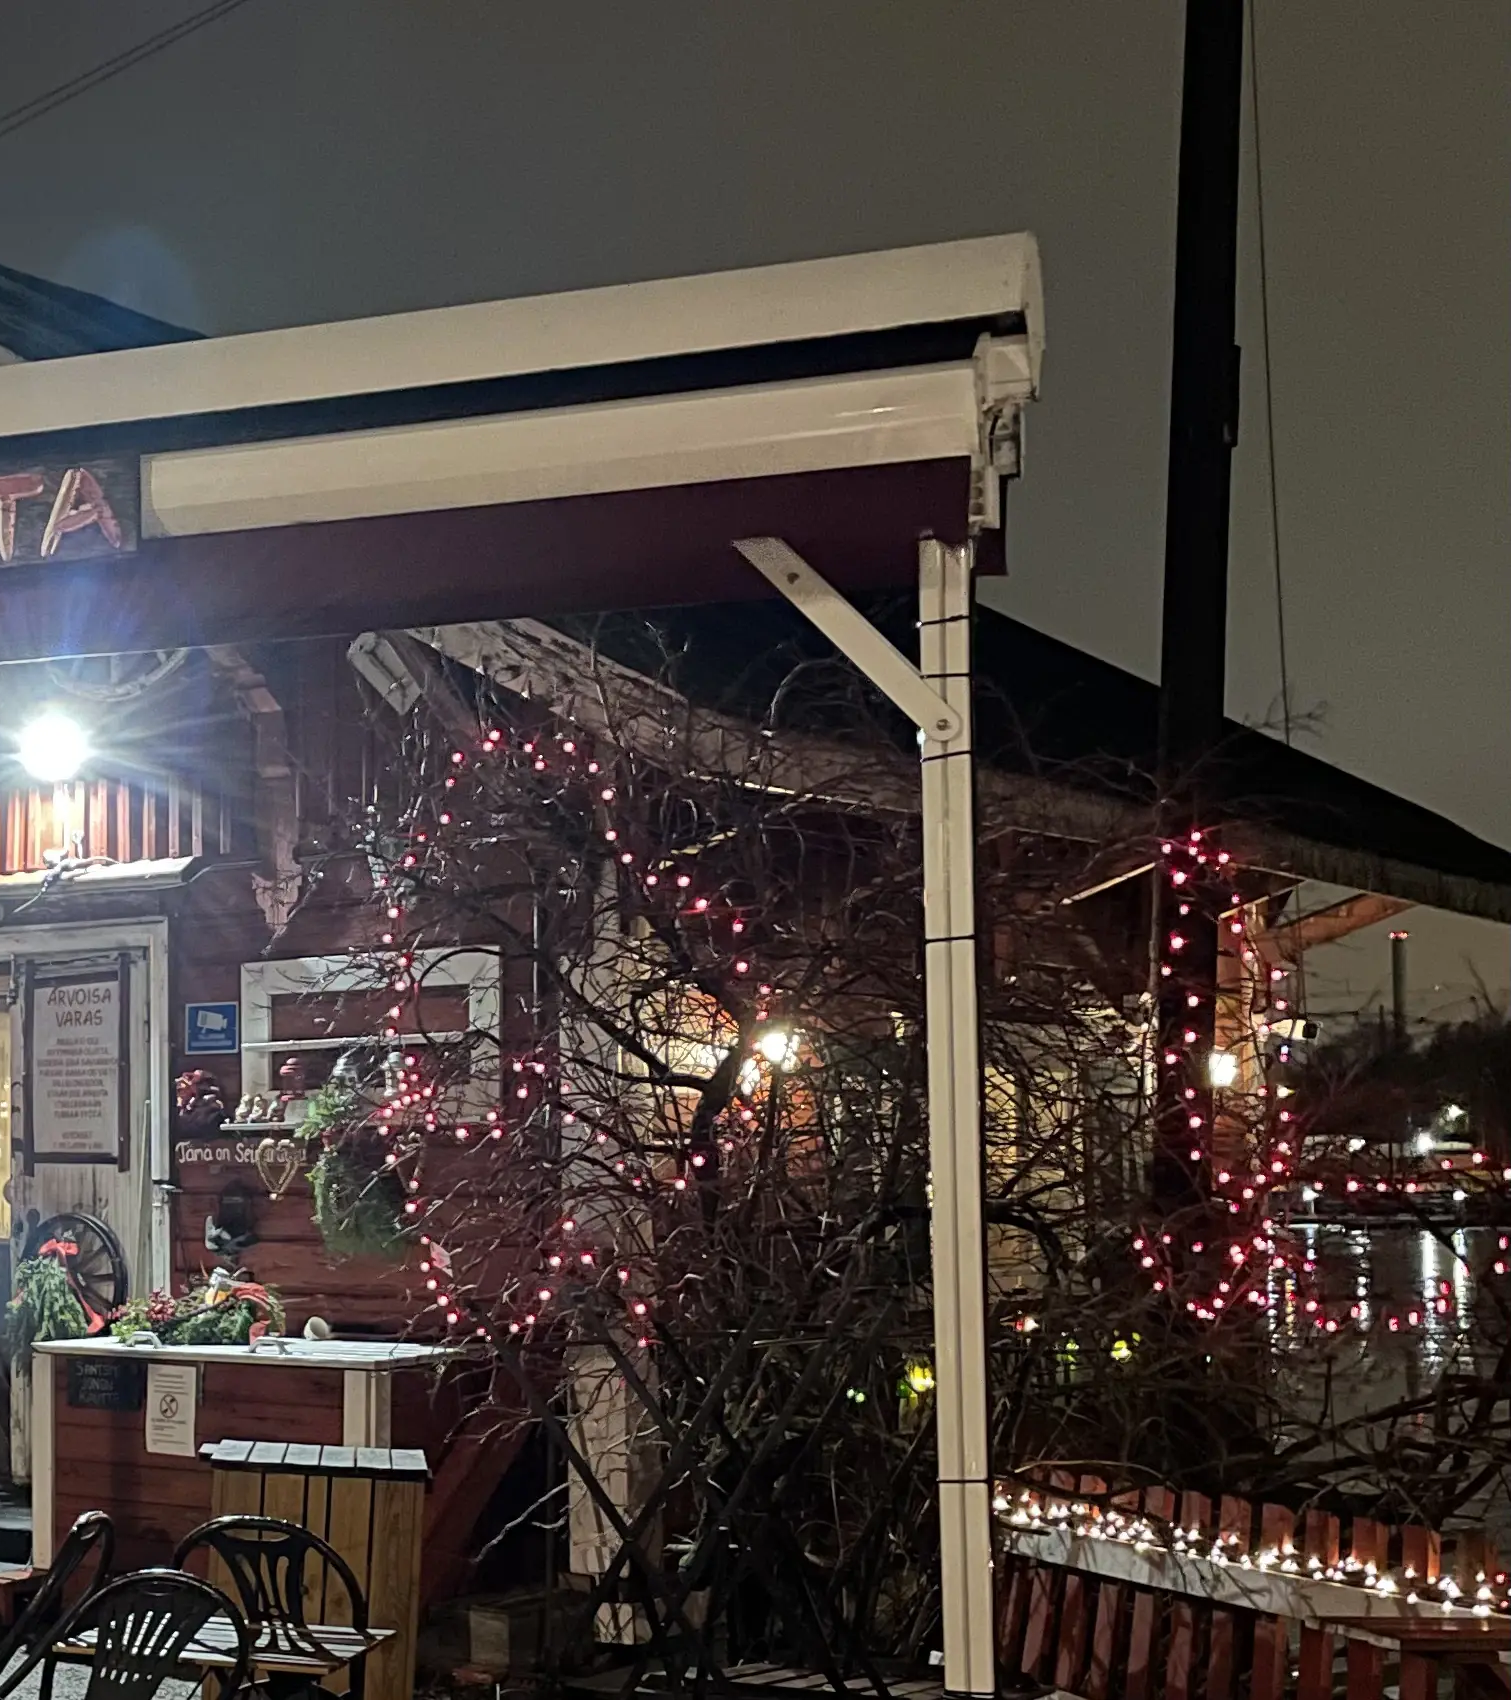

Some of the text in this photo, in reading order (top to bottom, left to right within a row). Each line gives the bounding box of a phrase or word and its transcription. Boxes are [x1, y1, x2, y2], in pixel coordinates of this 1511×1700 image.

[47, 986, 112, 1007] ARVOISA
[55, 1009, 103, 1027] VARAS
[216, 1148, 231, 1162] on
